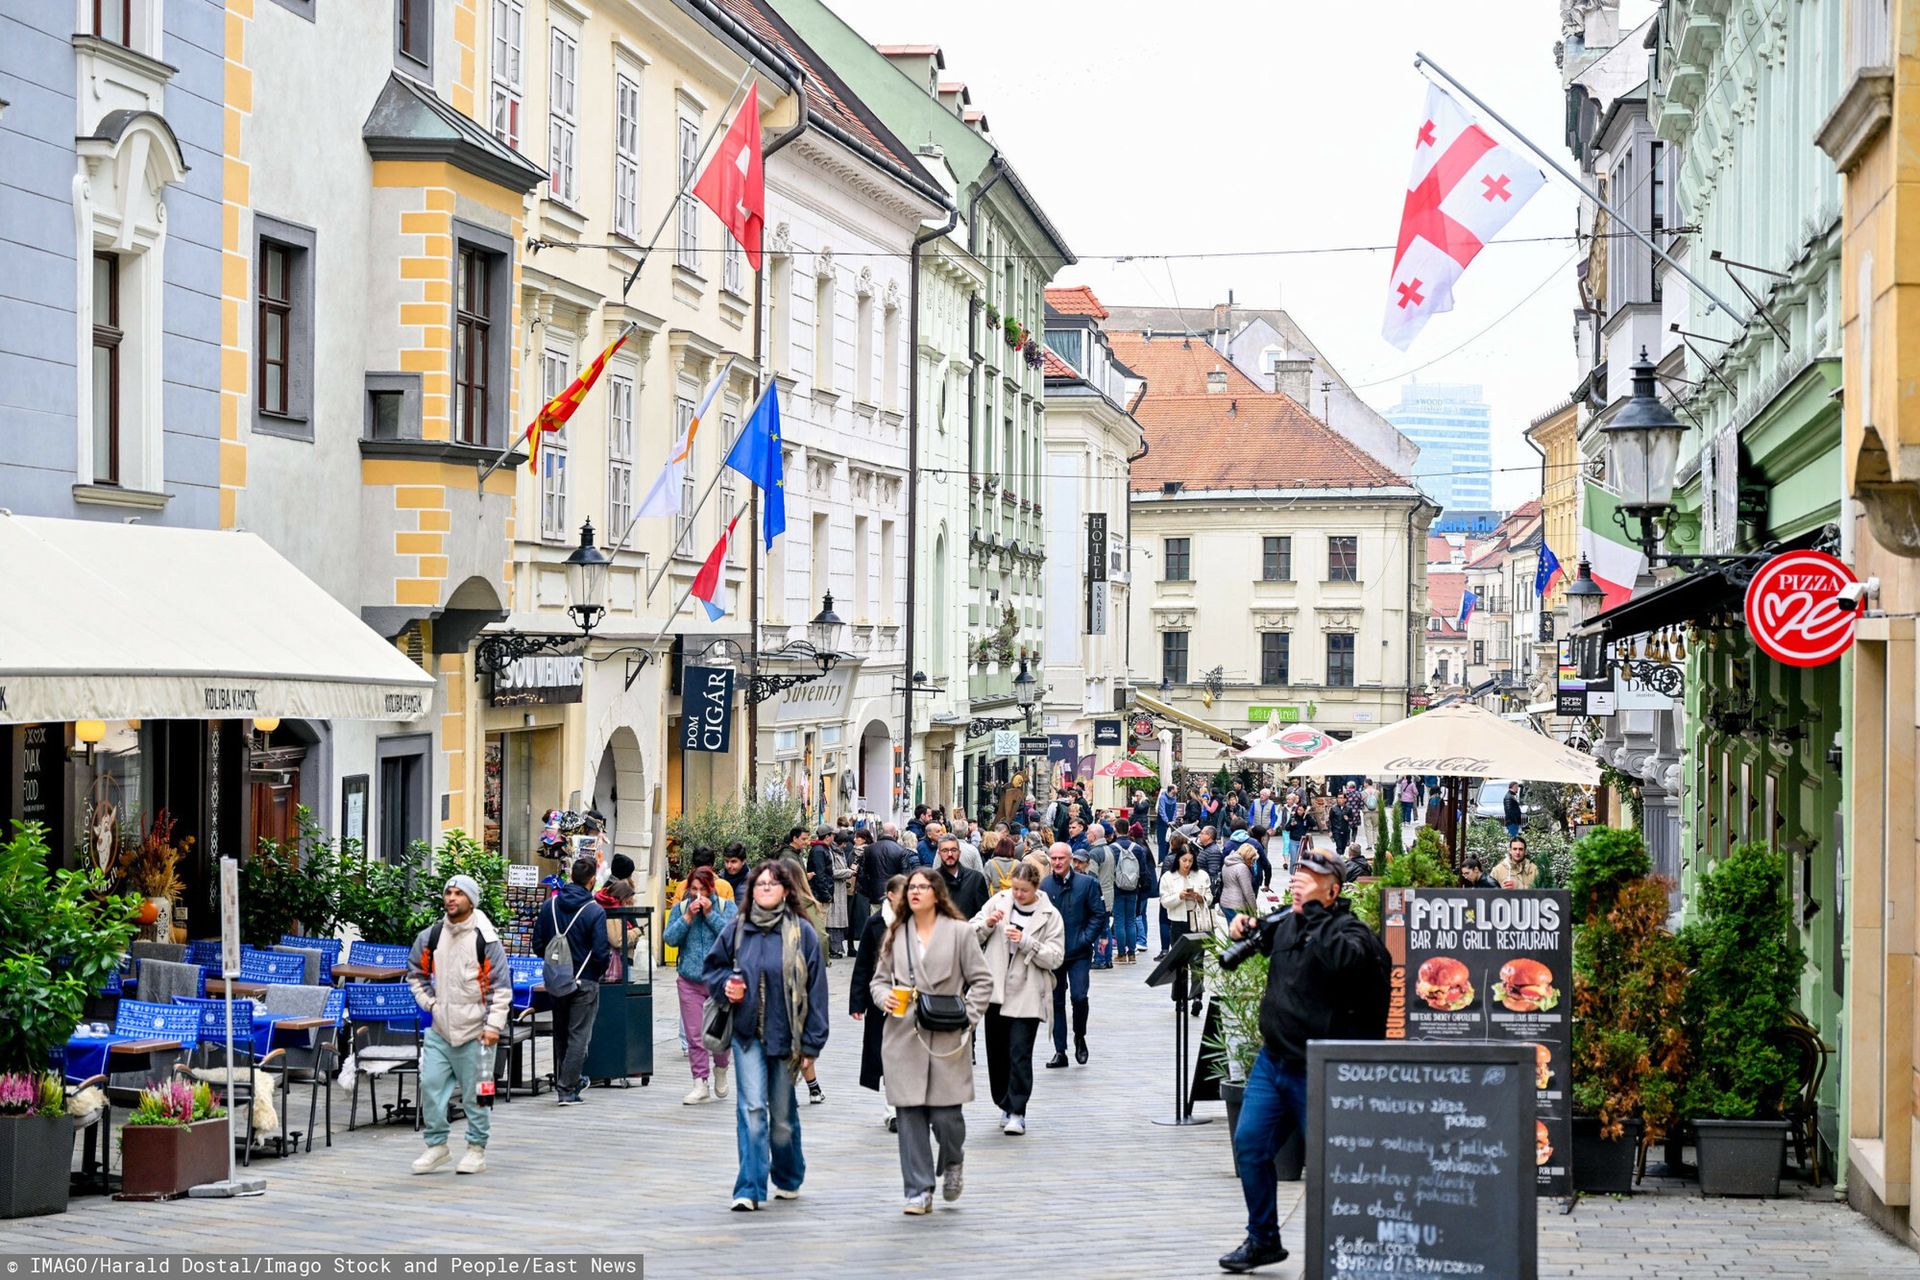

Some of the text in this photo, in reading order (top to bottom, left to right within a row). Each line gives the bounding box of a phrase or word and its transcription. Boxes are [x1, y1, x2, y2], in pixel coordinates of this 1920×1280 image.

[1092, 518, 1103, 579] HOTEL
[1778, 574, 1840, 592] PIZZA
[500, 656, 584, 689] SOUVENIRS
[204, 688, 230, 711] KOLIBA
[384, 694, 403, 713] KOLIBA
[703, 670, 727, 750] CIGÁR
[687, 716, 699, 748] DOM
[24, 749, 41, 773] OVAK
[1411, 898, 1561, 931] FAT LOUIS
[1411, 931, 1560, 950] BAR AND GRILL RESTAURANT
[1386, 966, 1406, 1039] BURGERS
[1337, 1064, 1472, 1084] SOUPCULTURE
